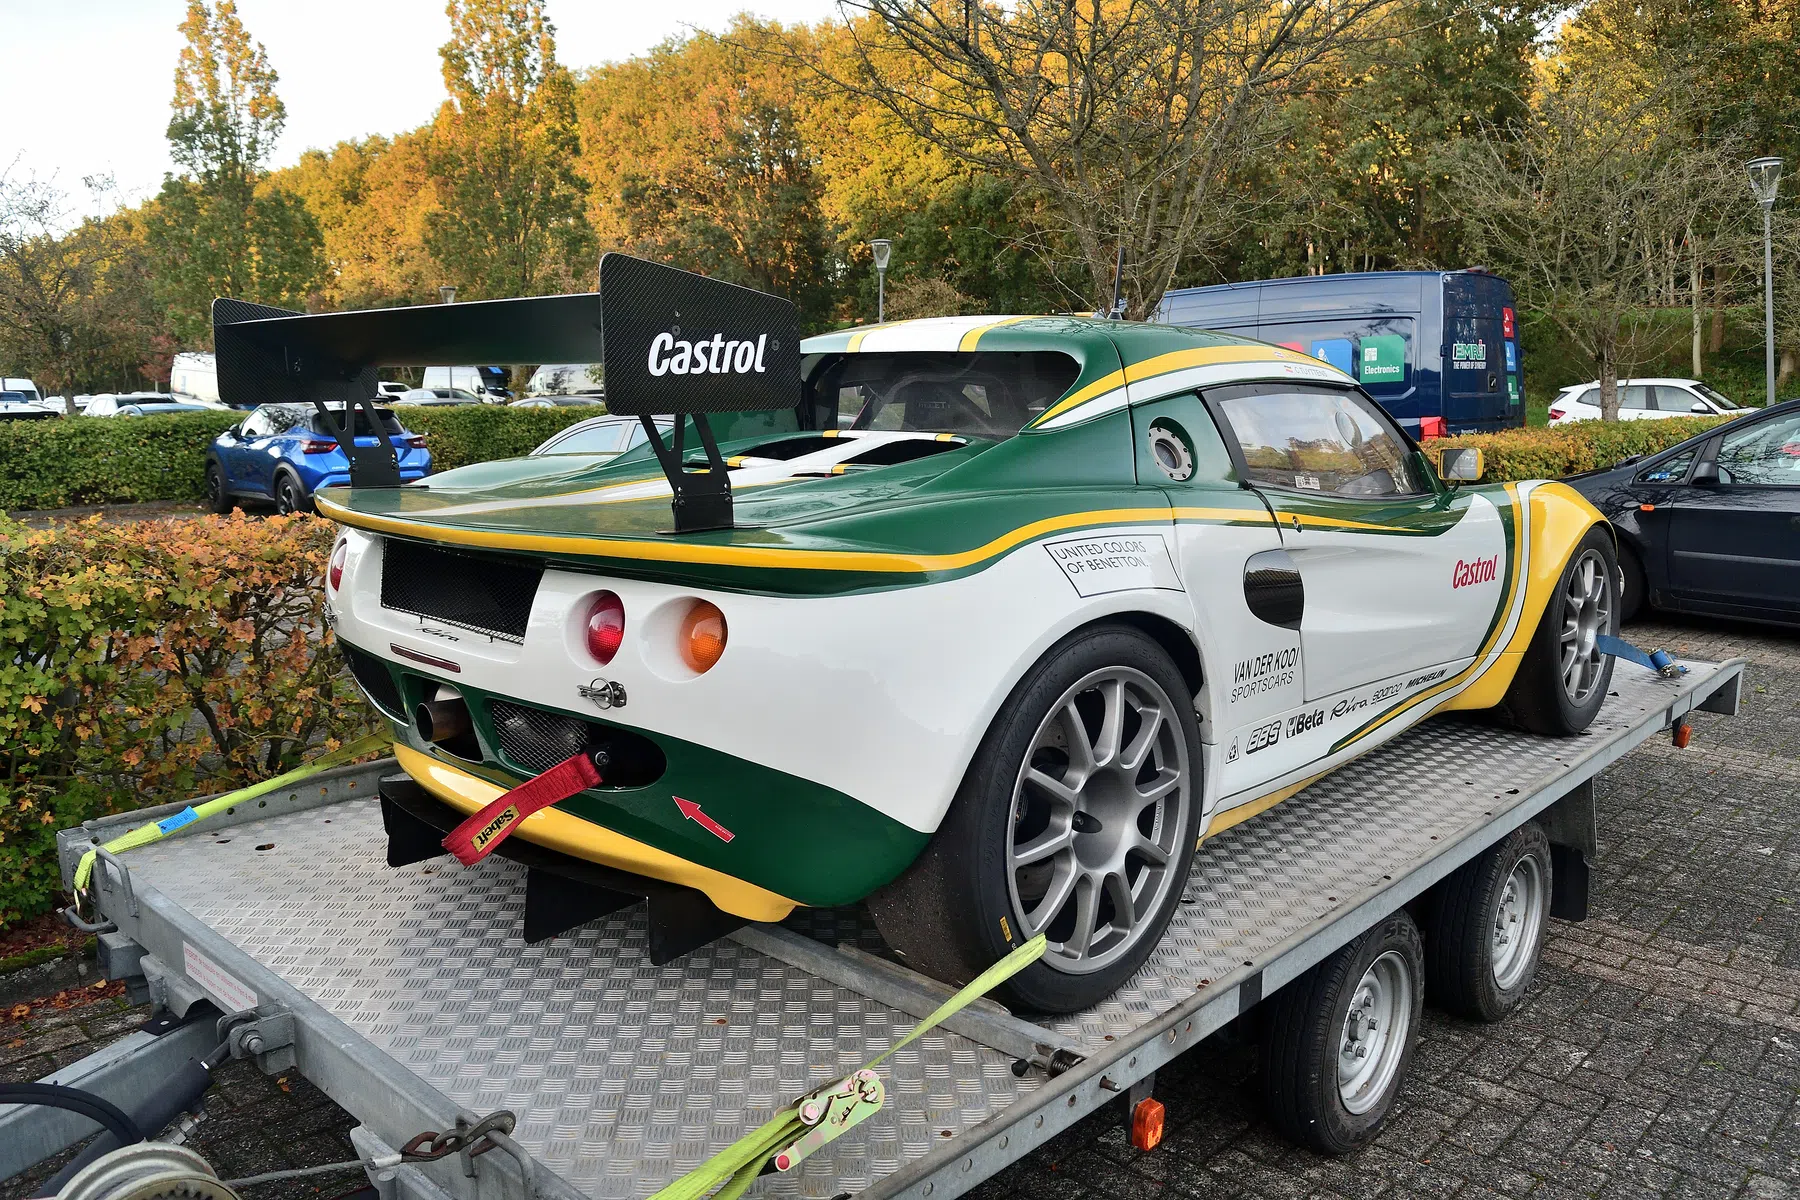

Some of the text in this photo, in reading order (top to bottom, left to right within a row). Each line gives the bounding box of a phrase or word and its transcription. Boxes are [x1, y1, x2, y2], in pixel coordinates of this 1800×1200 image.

[648, 332, 767, 377] Castrol
[1364, 364, 1400, 375] Electronics
[1054, 541, 1147, 560] UNITED COLORS
[1067, 561, 1085, 574] OF
[1453, 554, 1498, 589] Castrol
[1234, 647, 1300, 684] VAN DER KOOI
[1404, 668, 1448, 689] MICHELIN
[1231, 670, 1294, 703] SPORTSCARS
[1329, 696, 1368, 720] Riva
[1296, 709, 1325, 735] Beta
[476, 809, 514, 845] Sabelt
